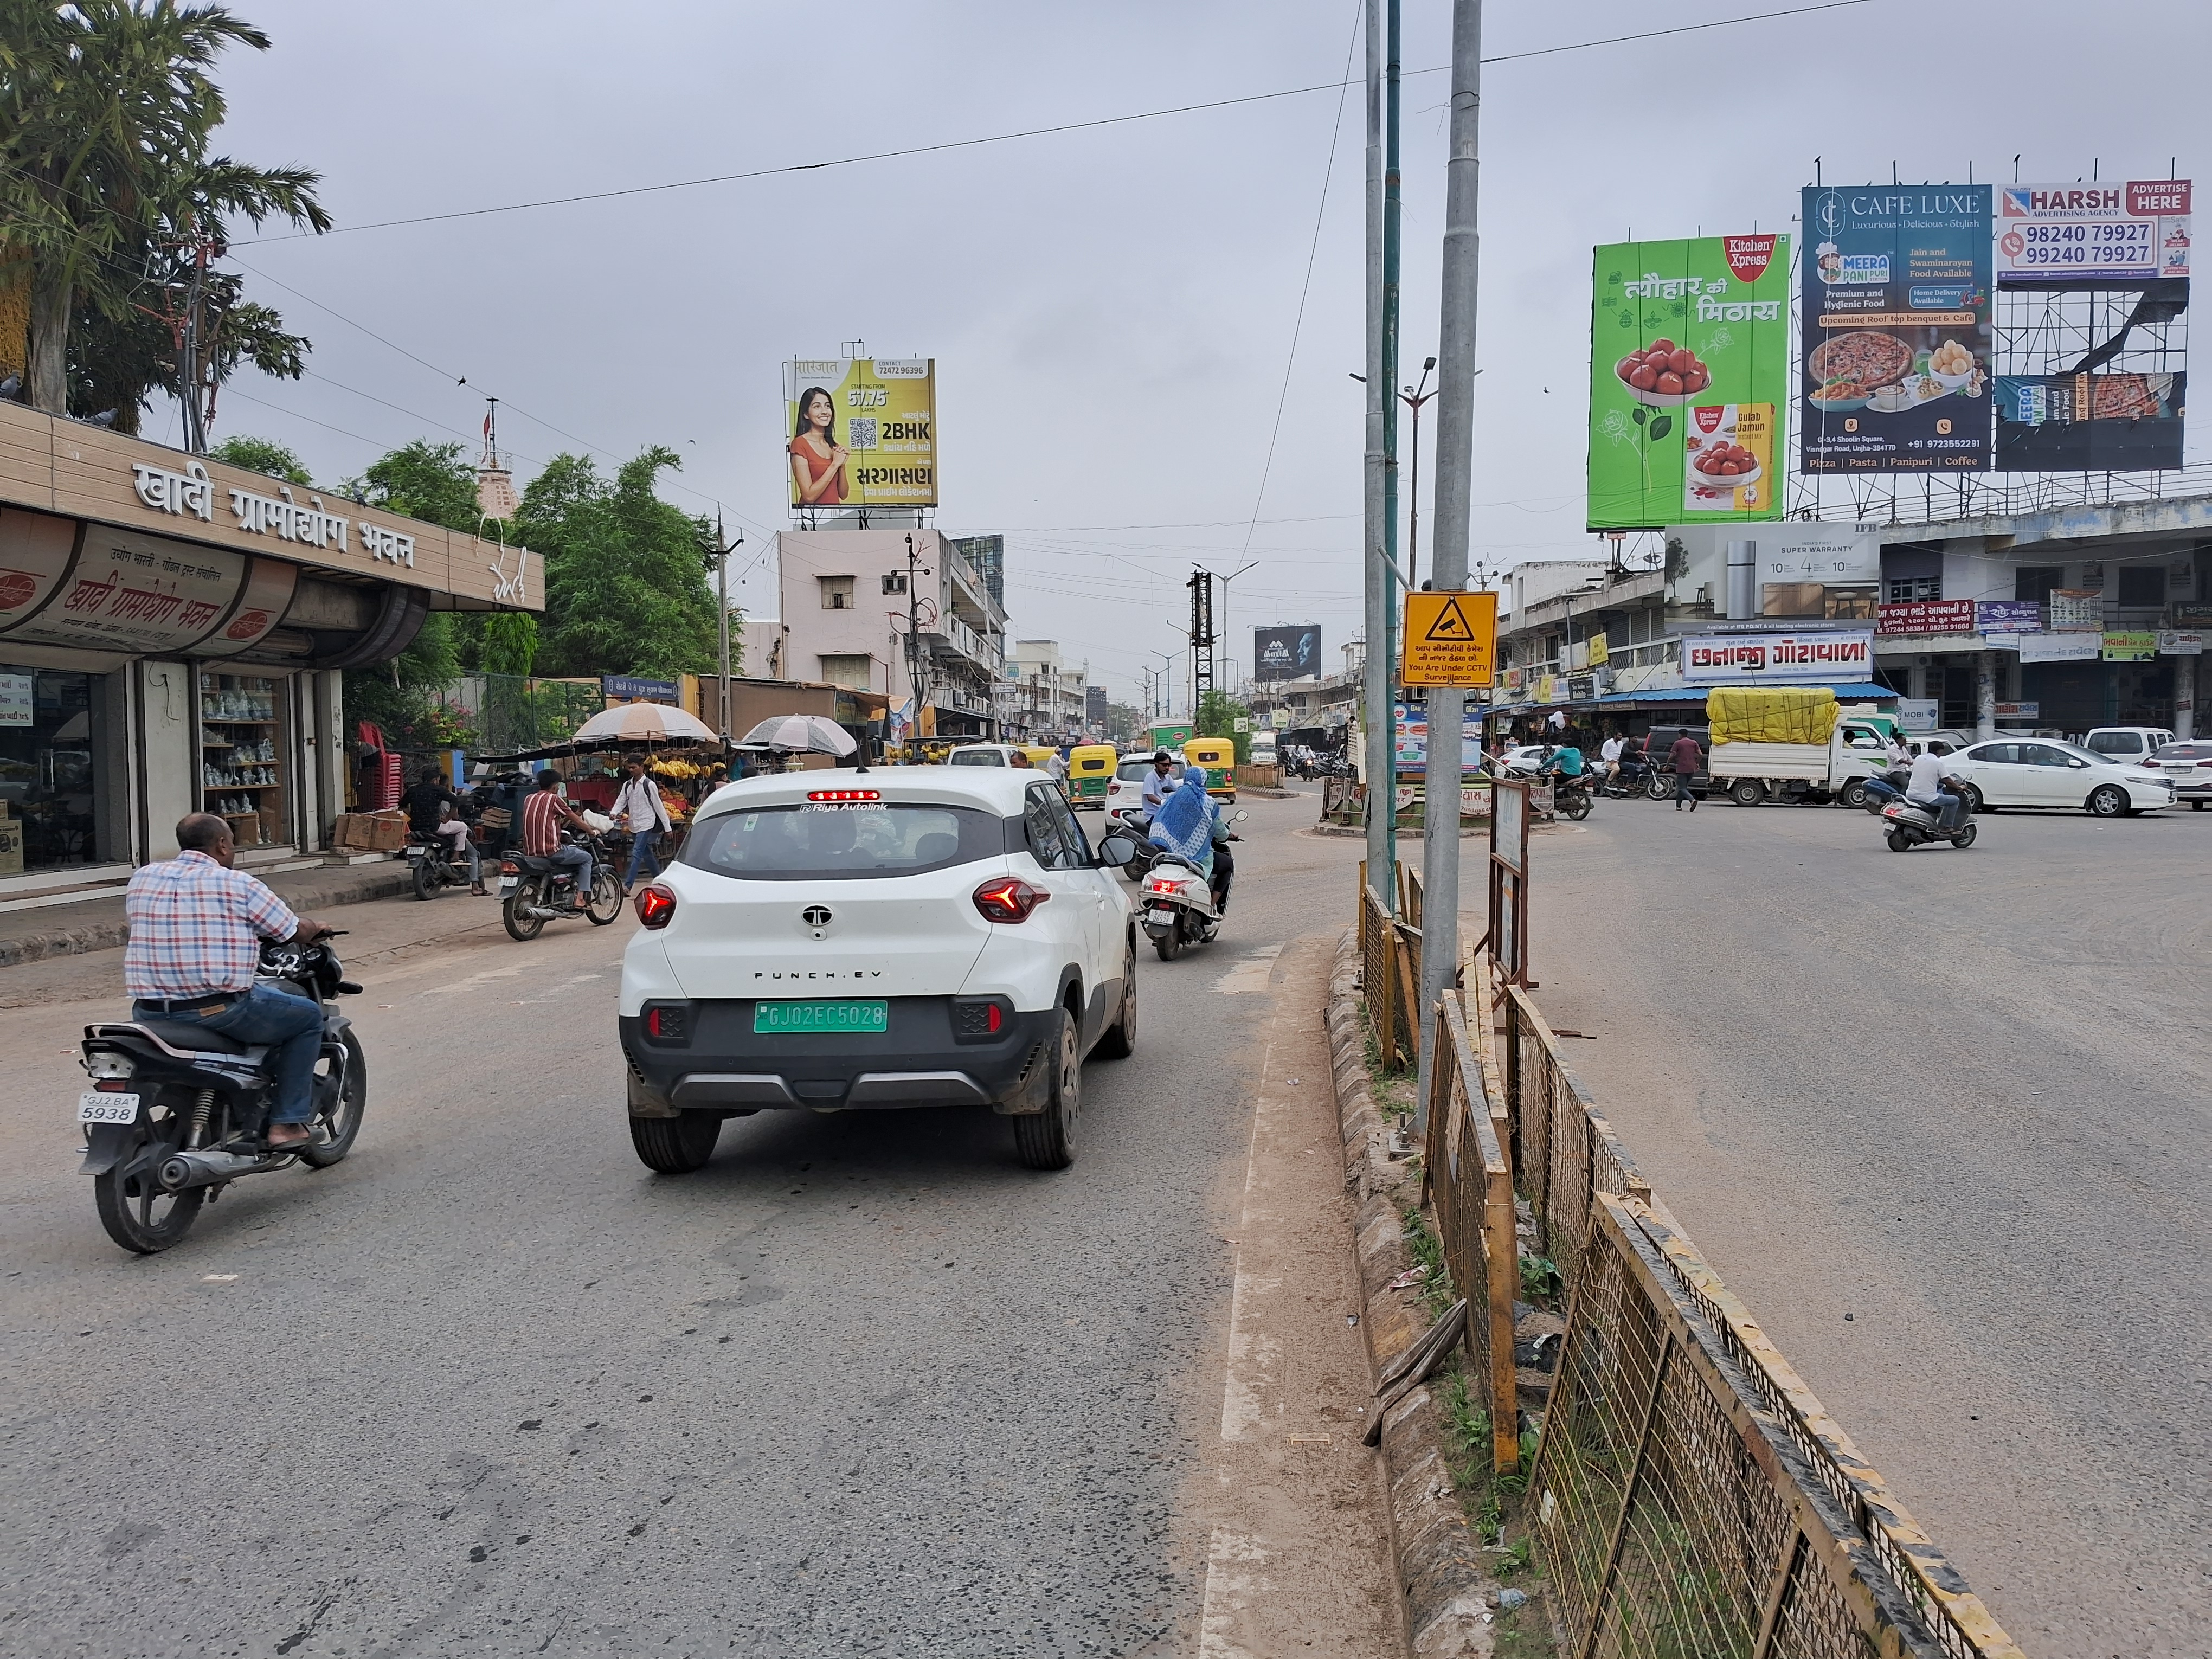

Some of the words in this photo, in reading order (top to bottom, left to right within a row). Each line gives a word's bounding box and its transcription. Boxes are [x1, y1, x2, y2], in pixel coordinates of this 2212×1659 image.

[2132, 184, 2188, 194] ADVERTISE
[1851, 196, 1913, 215] CAFE
[1921, 195, 1979, 214] LUXE
[2031, 190, 2119, 209] HARSH
[2138, 195, 2181, 209] HERE
[1851, 221, 1896, 229] Luxurious
[1904, 220, 1943, 228] Delicious
[1950, 219, 1979, 230] Stylish
[2027, 226, 2085, 243] 98240
[2092, 224, 2149, 241] 79927
[1729, 239, 1770, 252] Kitchen
[2027, 247, 2085, 263] 99240
[2092, 246, 2149, 262] 79927
[1731, 253, 1767, 269] Xpress
[1843, 257, 1887, 269] MEERA
[1844, 271, 1867, 281] PANI
[1624, 272, 1703, 300] त्यौहार
[1706, 278, 1728, 294] की
[1867, 289, 1883, 297] and
[1696, 294, 1780, 323] मिठास
[1824, 300, 1862, 310] Hygienic
[1863, 299, 1885, 307] Food
[1821, 316, 1865, 325] Upcoming
[1891, 316, 1904, 324] top
[1906, 315, 1941, 324] benquet
[2062, 389, 2070, 410] Food
[901, 410, 919, 422] આટલું
[1738, 412, 1760, 421] Gulab
[882, 422, 930, 440] 2BHK
[1738, 423, 1765, 432] Jamun
[918, 441, 931, 452] મળે
[1853, 445, 1896, 453] Unjha-384170
[1908, 440, 1923, 448] +91
[1927, 439, 1980, 448] 9723552291
[1809, 459, 1836, 467] Pizza
[1849, 459, 1877, 467] Pasta
[1890, 456, 1932, 467] Panipuri
[1945, 457, 1978, 465] Coffee
[857, 468, 932, 485] સરગાસણ
[898, 485, 933, 496] લોકેશનમાં
[132, 460, 215, 522] खादी
[228, 486, 349, 553] ग्रामोद्योग
[358, 520, 415, 569] भवन
[1855, 524, 1877, 532] IFB
[133, 552, 156, 568] भारती
[196, 563, 222, 583] संचालित
[1771, 563, 1783, 573] 10
[1800, 556, 1812, 573] 4
[1832, 562, 1844, 571] 10
[63, 569, 117, 616] खादी
[178, 599, 221, 631] भवन
[1889, 608, 1908, 618] જગ્યા
[1911, 603, 1925, 616] ભાડે
[1928, 602, 1959, 615] આપવાની
[1962, 601, 1971, 614] છે.
[2104, 635, 2127, 646] ભવાની
[1432, 644, 1464, 652] સીસીટીવી
[1467, 644, 1483, 652] કેમેરા
[1448, 653, 1465, 662] હેઠળ
[1692, 646, 1765, 671] છનાજી
[1424, 673, 1472, 681] Surveillance
[813, 803, 839, 813] Riya
[840, 803, 889, 811] Autolink
[769, 1006, 884, 1026] GJ02EC5028
[82, 1107, 131, 1121] 5938
